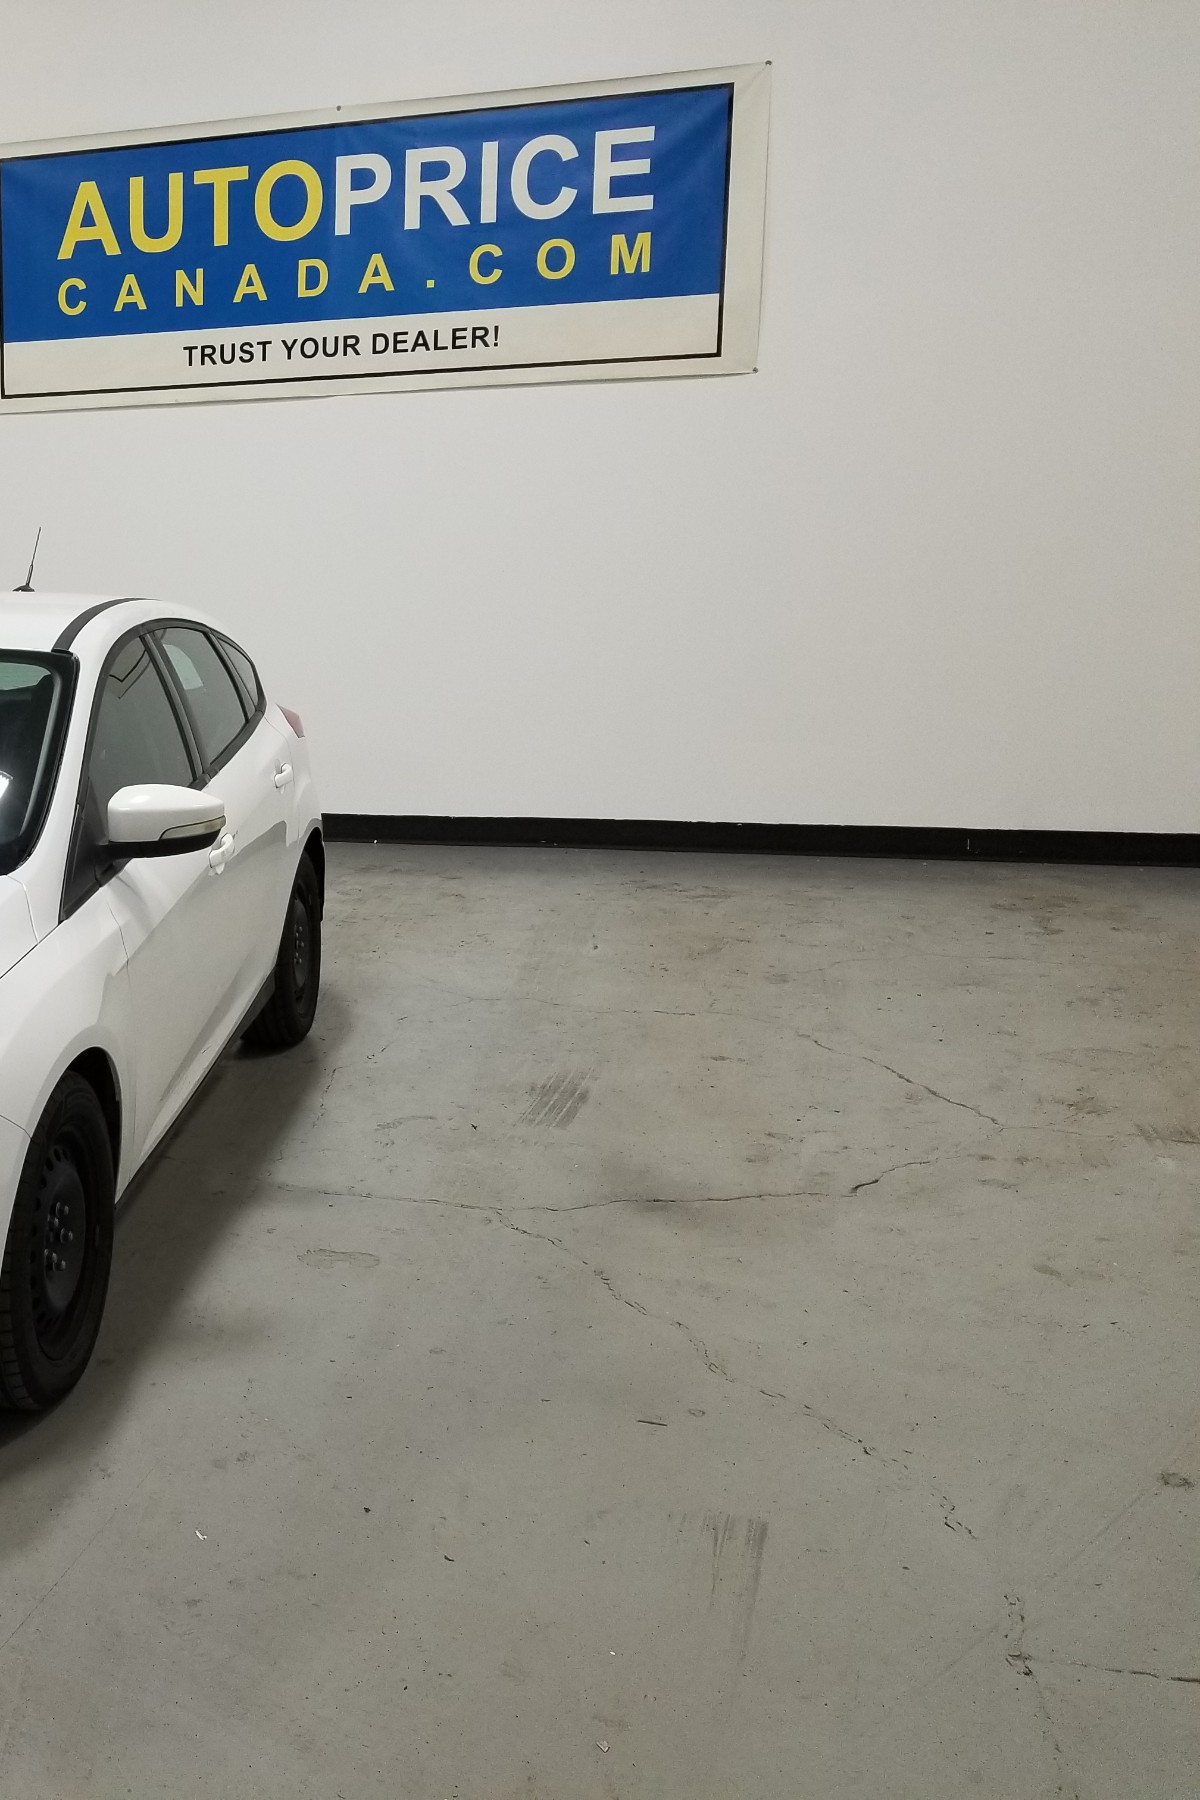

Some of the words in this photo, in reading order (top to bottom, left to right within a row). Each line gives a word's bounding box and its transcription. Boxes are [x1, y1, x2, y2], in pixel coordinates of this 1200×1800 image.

[57, 125, 656, 260] AUTOPRICE
[57, 232, 652, 315] CANADA.COM
[182, 341, 273, 367] TRUST
[281, 334, 362, 360] YOUR
[372, 325, 501, 356] DEALER!
